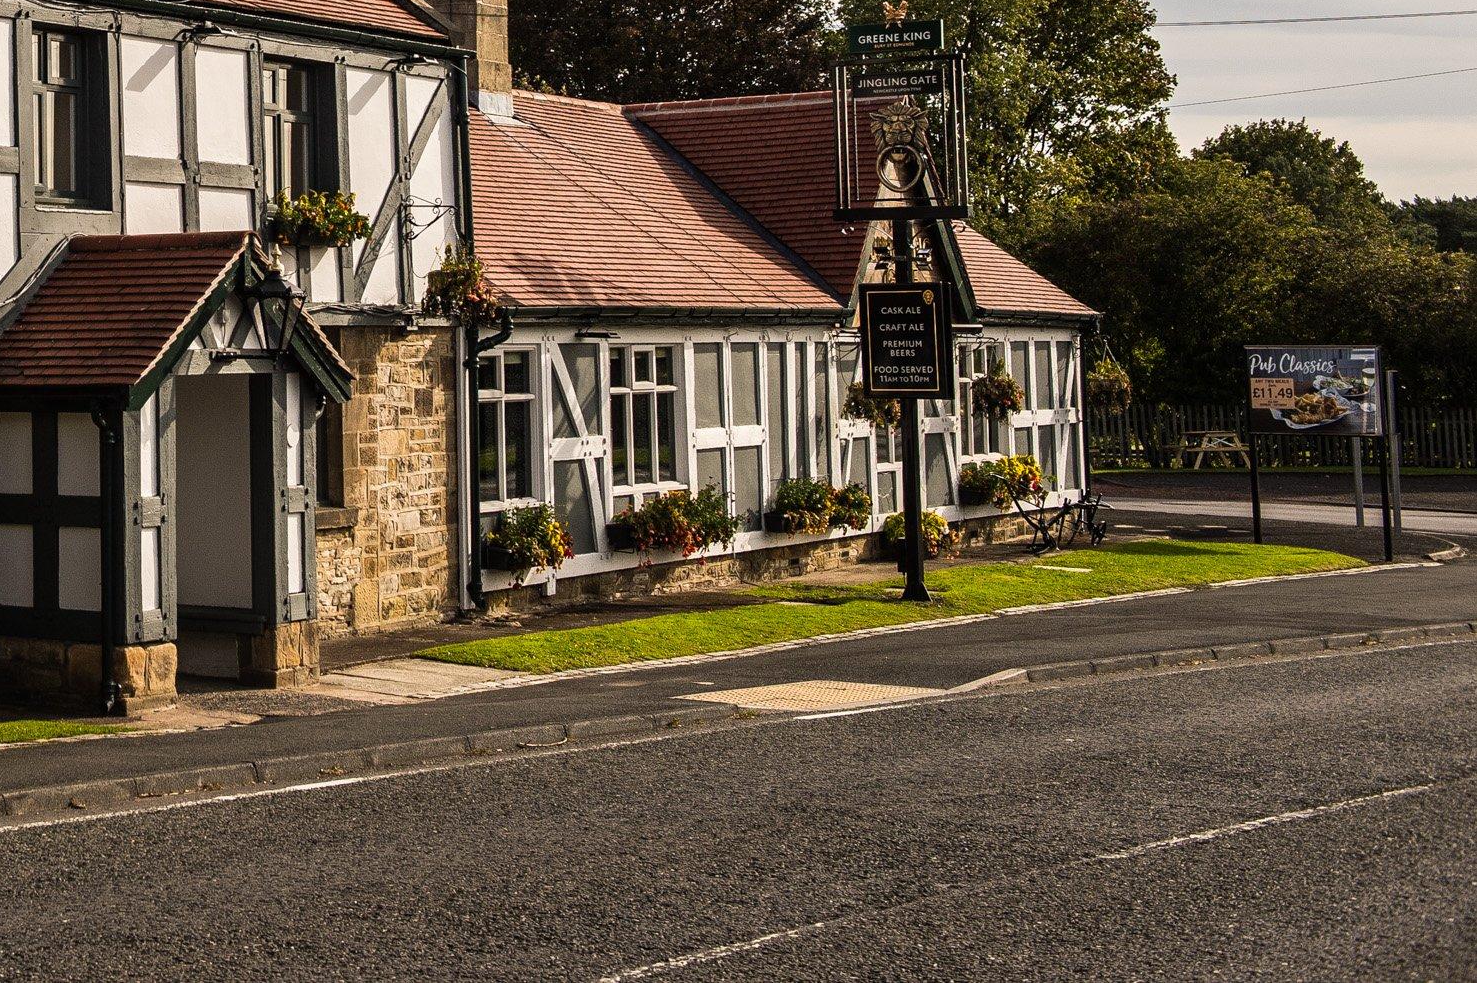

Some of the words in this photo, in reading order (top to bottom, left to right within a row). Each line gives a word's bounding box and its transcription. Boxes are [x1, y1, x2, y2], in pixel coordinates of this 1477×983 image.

[858, 33, 900, 45] GREENE
[903, 31, 931, 42] KING
[857, 77, 908, 89] JINGLING
[909, 75, 938, 86] GATE
[880, 307, 904, 315] CASK
[882, 340, 923, 348] PREMIUM
[890, 349, 916, 357] BEERS
[1248, 353, 1277, 375] Pub
[1279, 352, 1336, 374] Classics
[874, 365, 899, 374] FOOD
[900, 365, 934, 374] SERVED
[1252, 387, 1293, 399] £11.49
